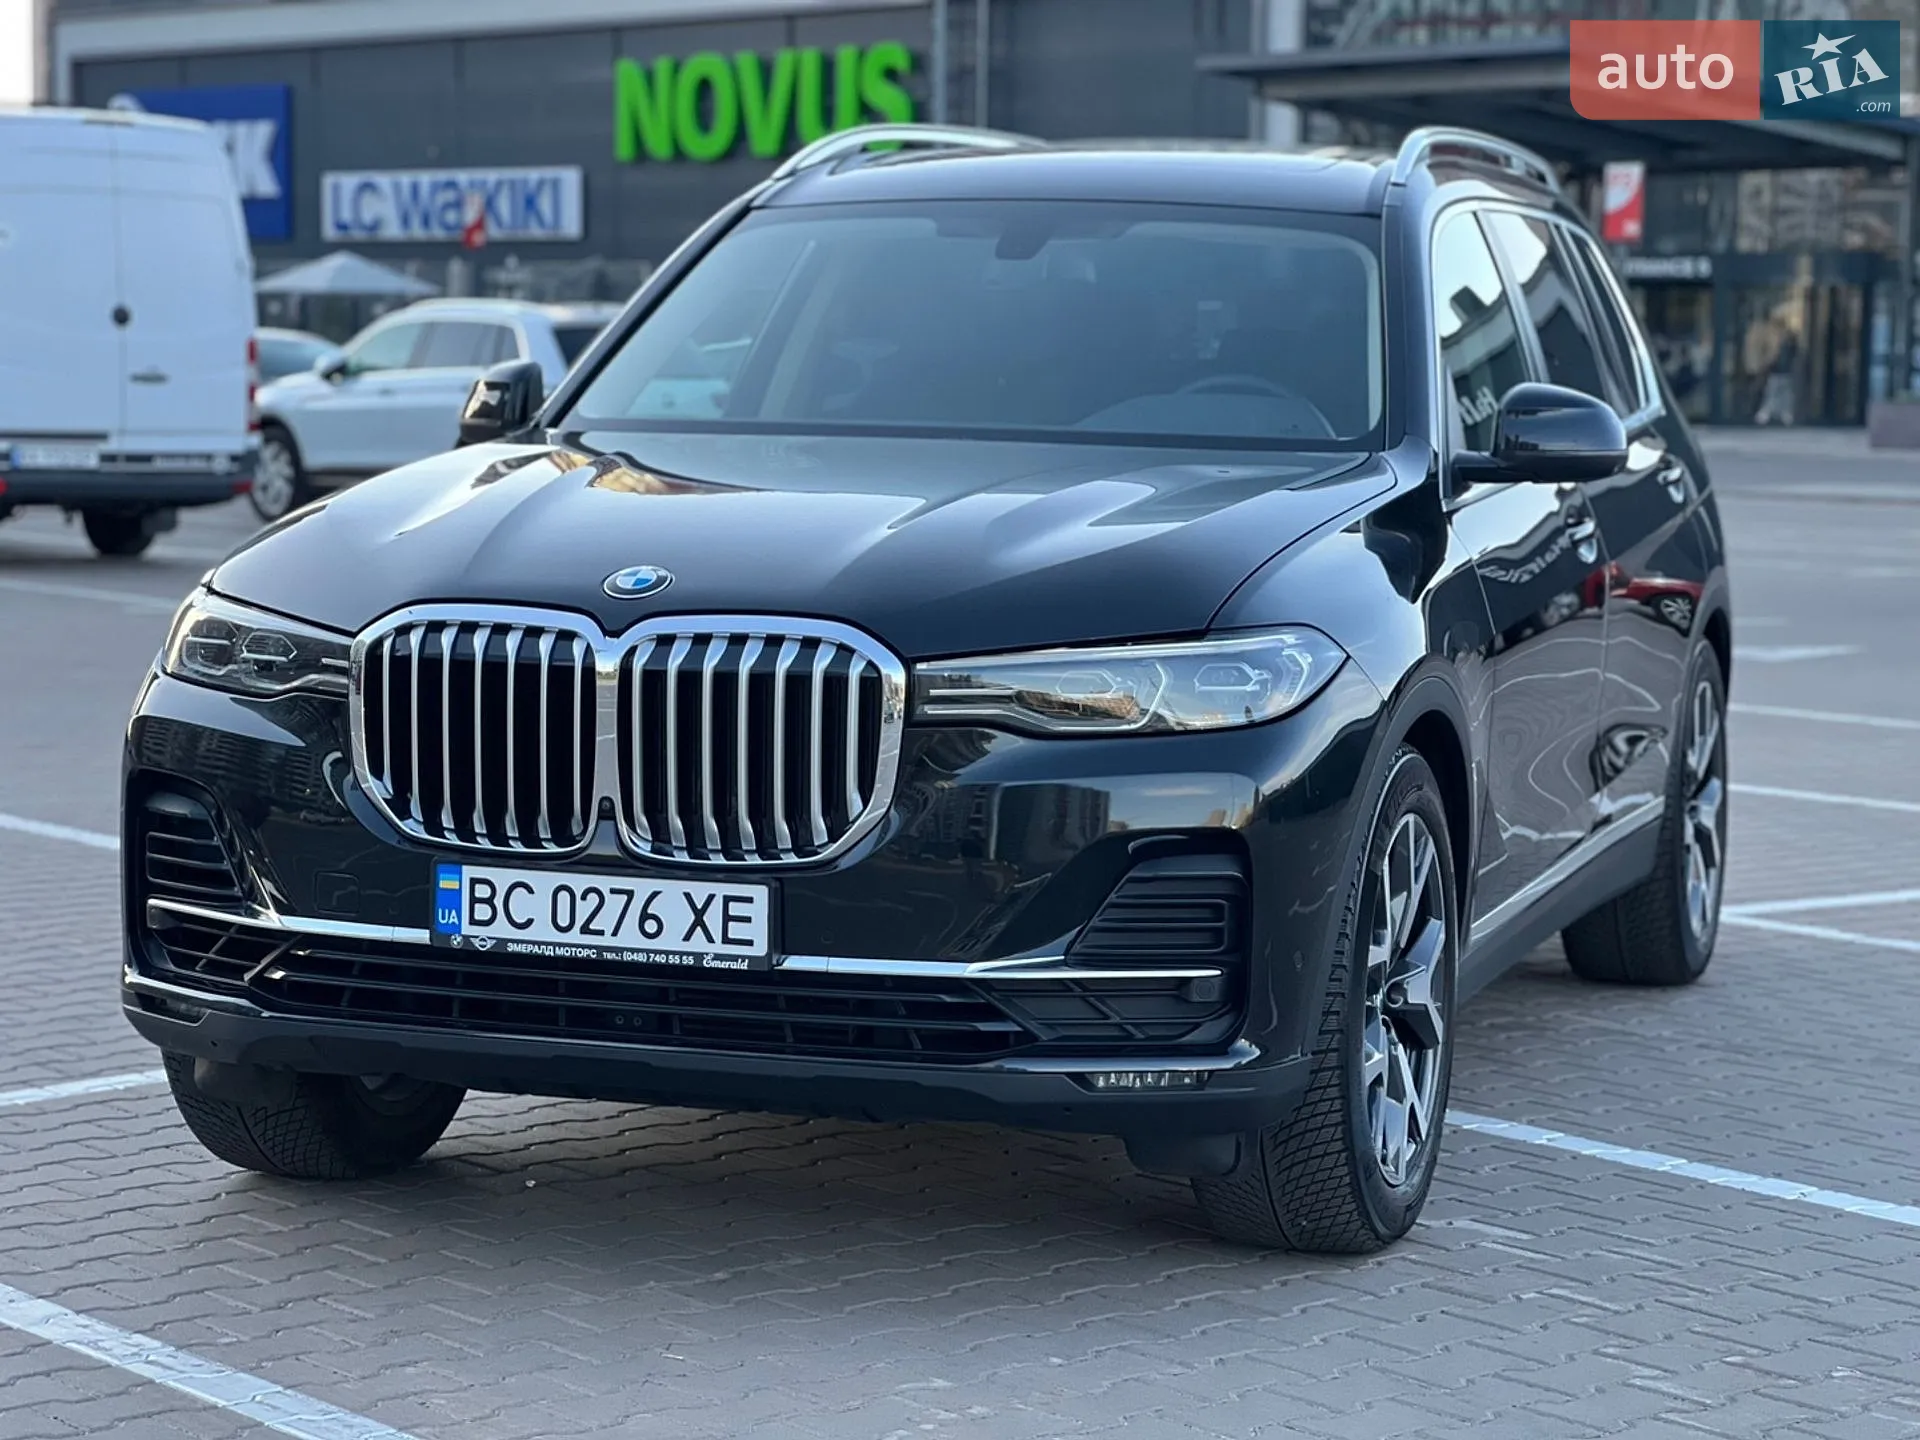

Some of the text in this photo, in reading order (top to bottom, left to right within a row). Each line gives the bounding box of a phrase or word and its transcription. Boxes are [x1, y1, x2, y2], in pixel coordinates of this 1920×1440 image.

[614, 40, 912, 163] NOVUS
[331, 180, 384, 233] LC
[438, 908, 459, 925] UA
[468, 877, 755, 947] BC 0276 XE
[506, 942, 554, 957] ЭМЕРАЛД
[555, 946, 597, 958] МОТОРС
[649, 953, 667, 964] 740
[668, 954, 681, 964] 55
[681, 955, 695, 965] 55
[702, 953, 748, 970] Emerald
